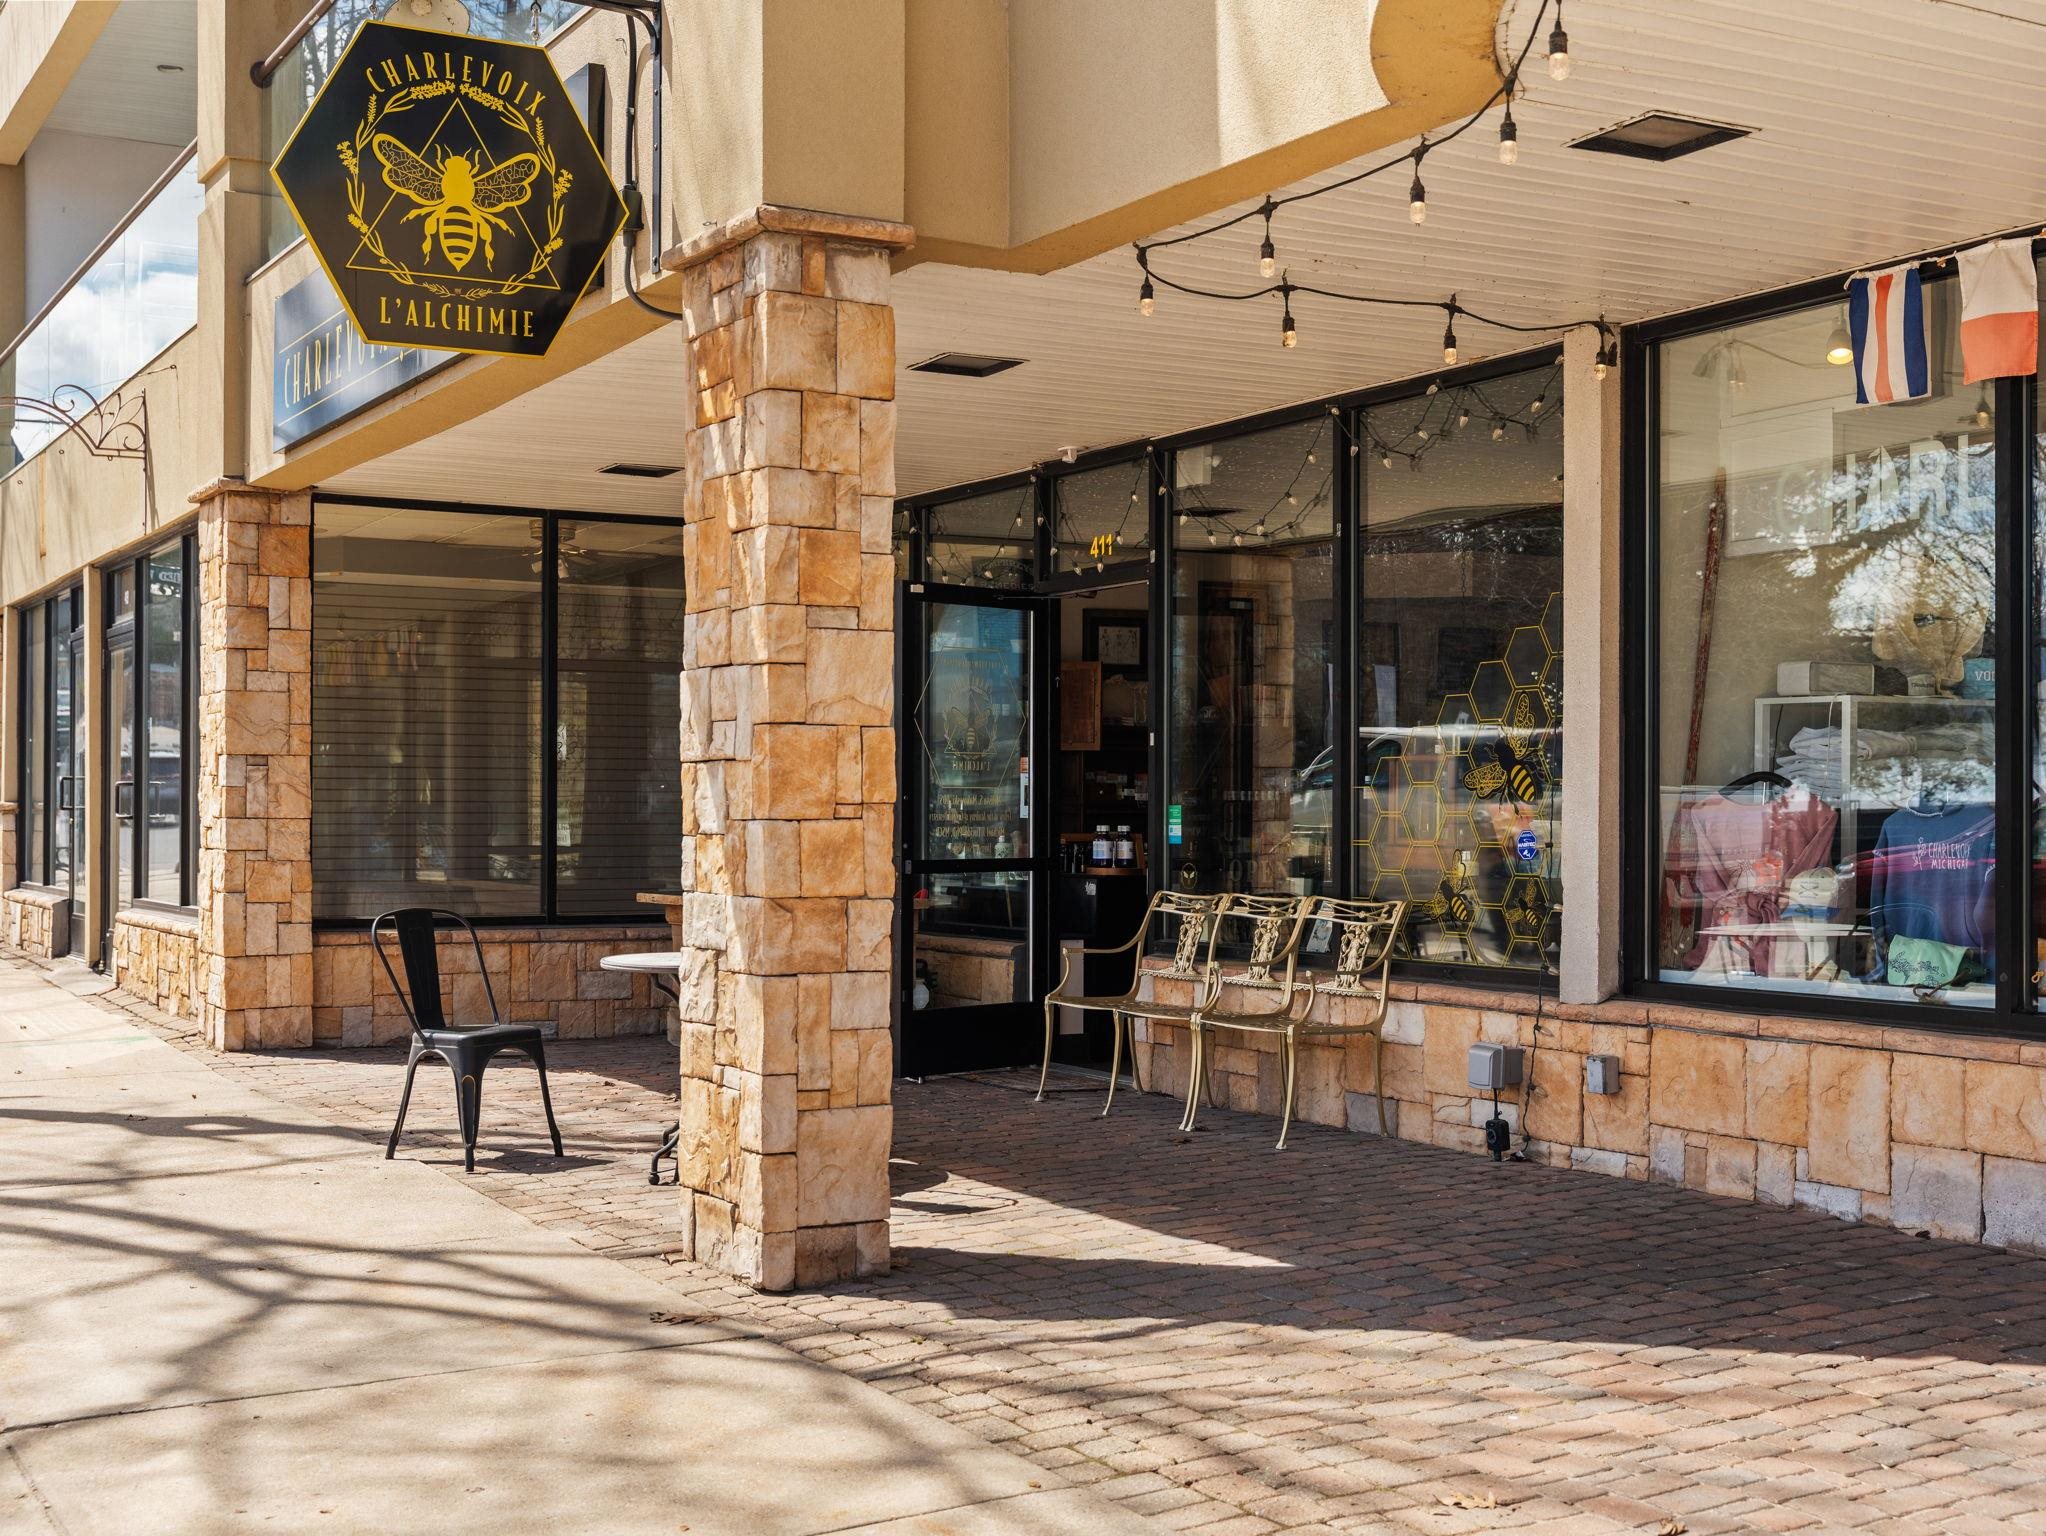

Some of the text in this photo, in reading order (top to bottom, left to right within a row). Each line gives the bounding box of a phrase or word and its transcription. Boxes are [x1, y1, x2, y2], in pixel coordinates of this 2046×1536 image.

[365, 51, 547, 117] CHARLEVOIX
[379, 296, 535, 338] L'ALCHIMIE
[1090, 533, 1113, 559] 411
